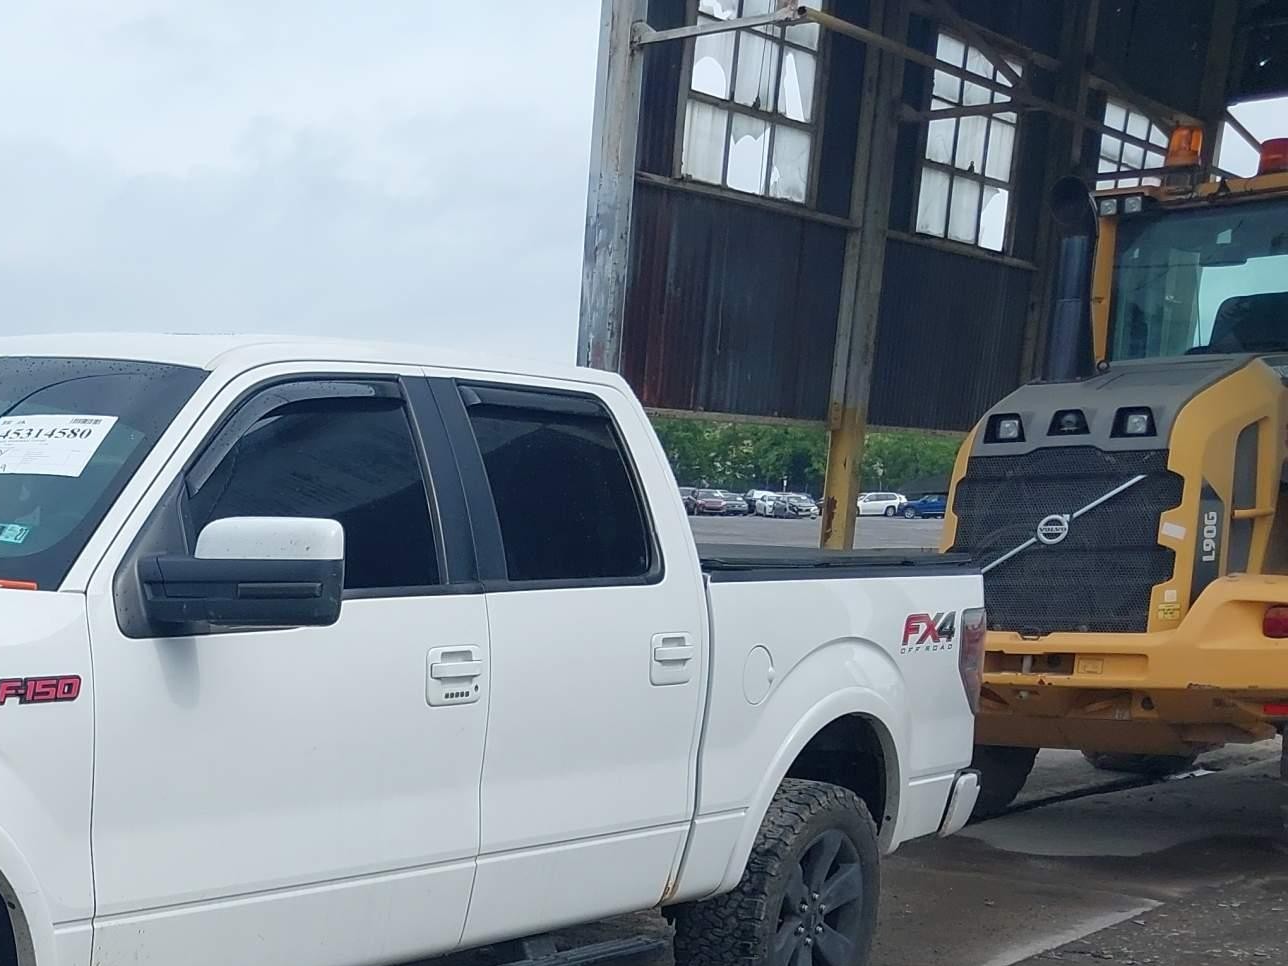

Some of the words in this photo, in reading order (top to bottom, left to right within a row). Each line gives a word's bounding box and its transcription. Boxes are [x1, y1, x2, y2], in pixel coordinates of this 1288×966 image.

[0, 428, 92, 440] 45314580
[1202, 511, 1217, 562] L90G
[902, 611, 957, 646] FX4
[900, 646, 920, 655] OFF
[925, 643, 953, 653] ROAD
